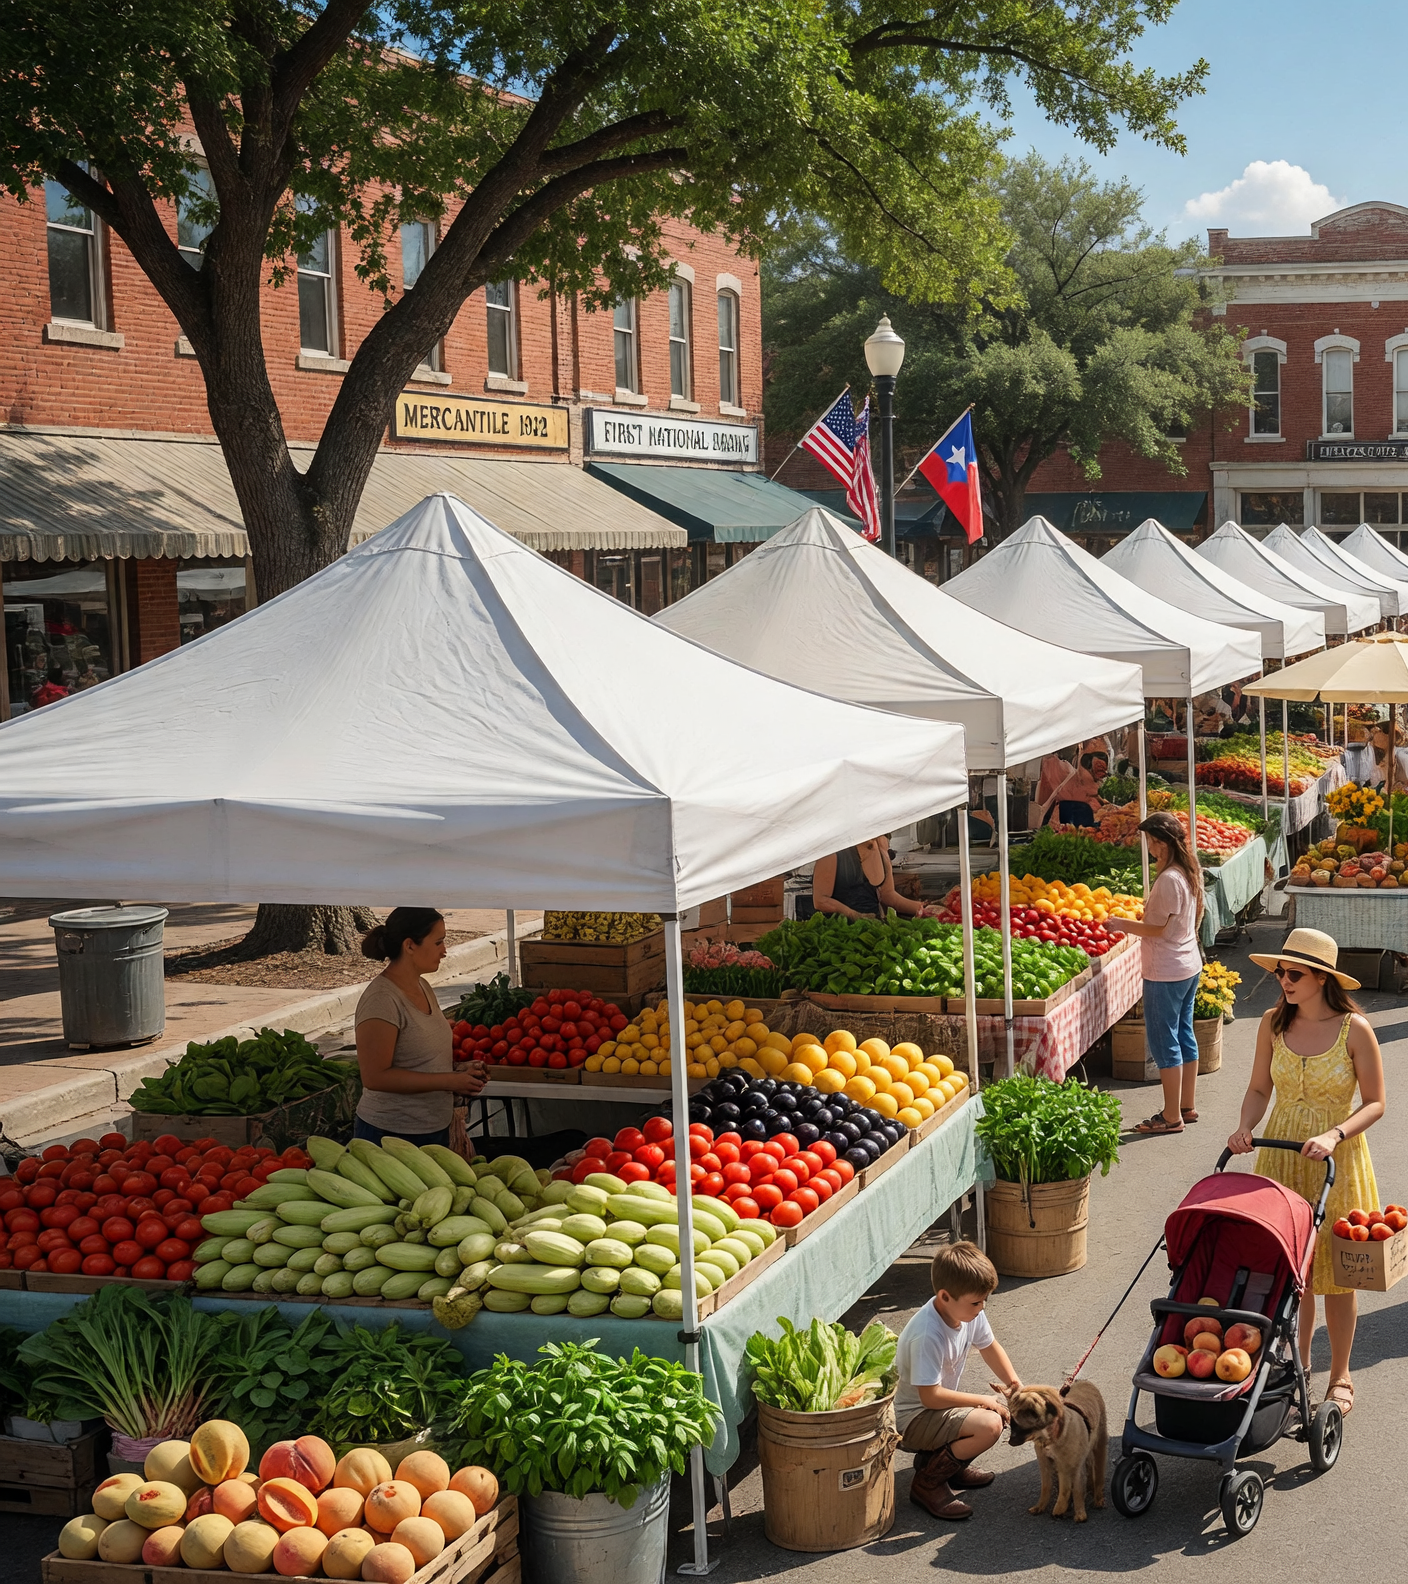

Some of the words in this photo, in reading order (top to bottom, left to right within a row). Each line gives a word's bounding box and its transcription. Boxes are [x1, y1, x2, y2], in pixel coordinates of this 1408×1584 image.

[403, 403, 510, 434] MERCANTILE
[604, 421, 643, 445] FIRST
[649, 426, 709, 450] NATIONAL
